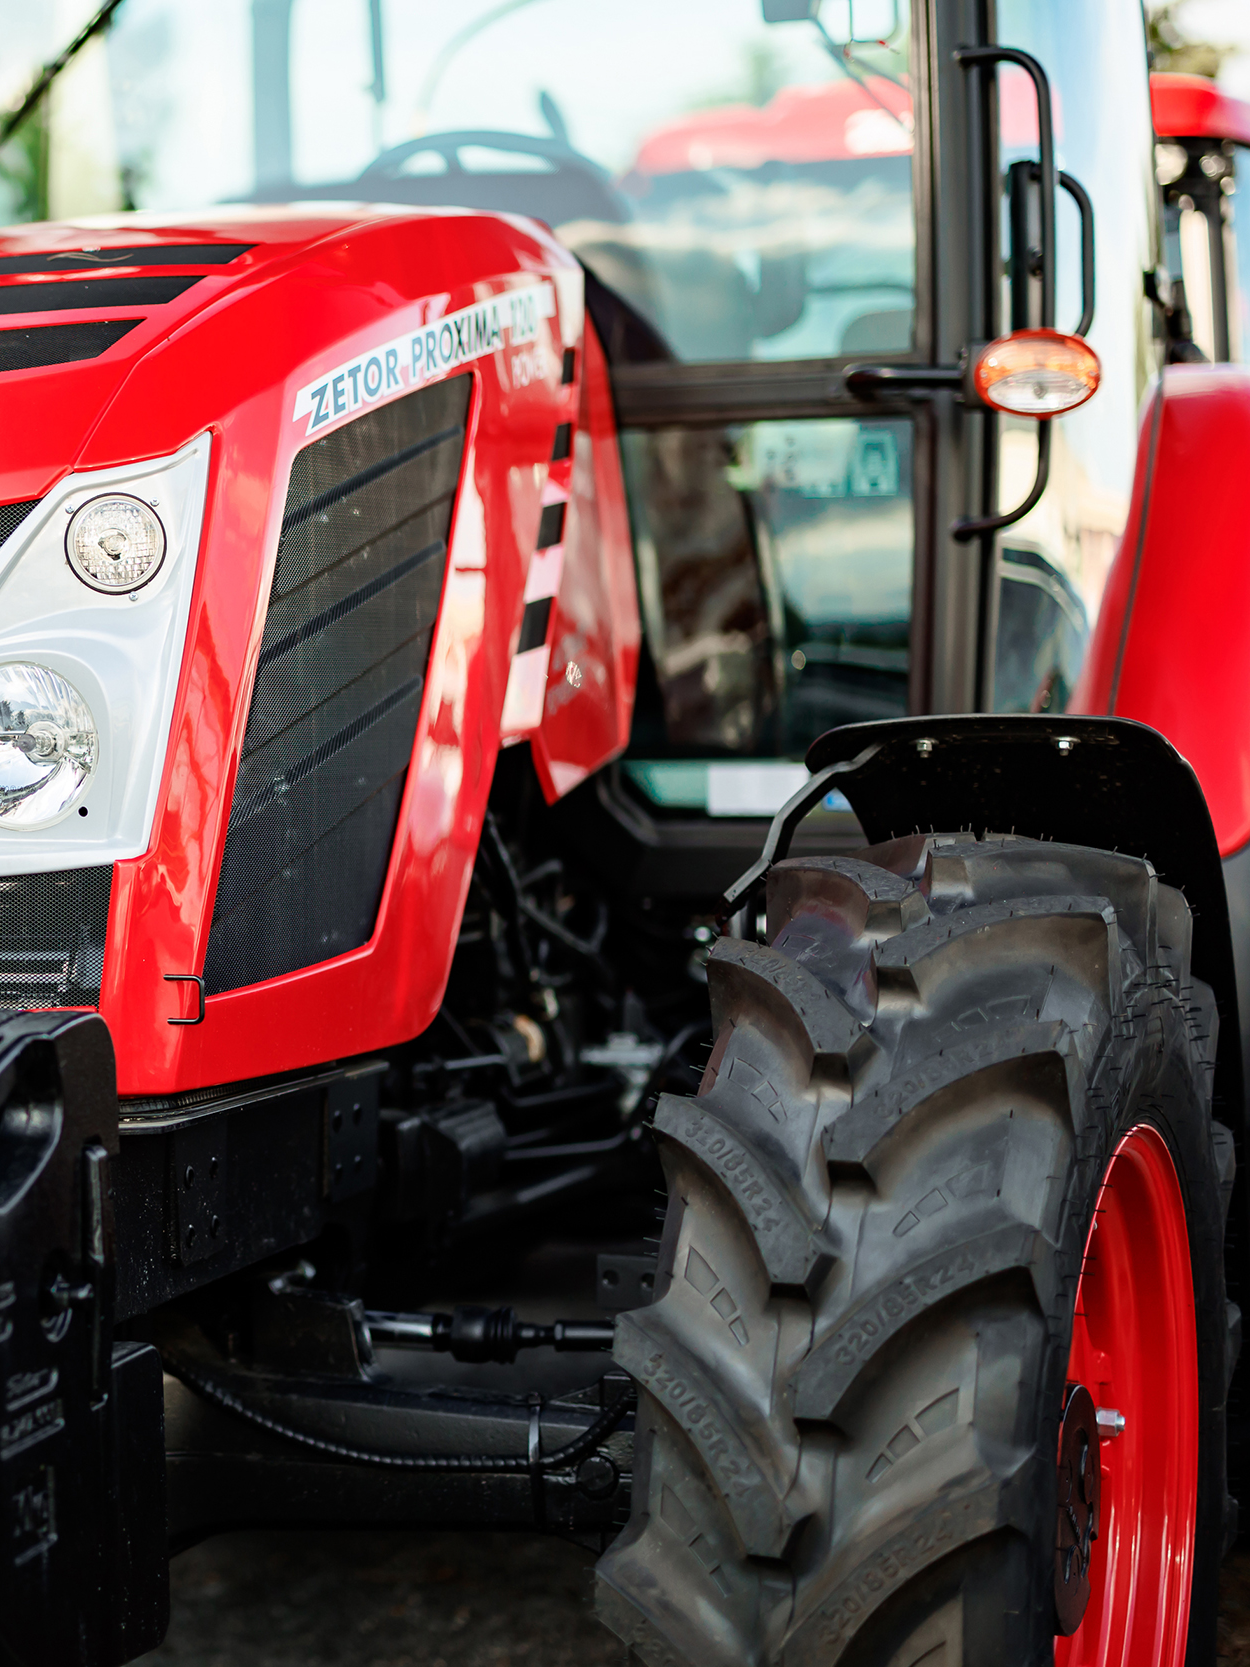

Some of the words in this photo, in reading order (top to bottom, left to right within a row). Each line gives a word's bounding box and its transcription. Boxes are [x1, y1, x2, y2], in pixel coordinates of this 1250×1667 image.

[311, 348, 400, 430] ZETOR
[411, 305, 501, 378] PROXIMA
[510, 347, 551, 390] POWE
[872, 1042, 998, 1119] 320/85R2
[684, 1116, 781, 1233] 320/85R24
[834, 1253, 977, 1366] 320/85R24
[643, 1353, 751, 1498] 320/85R24
[819, 1508, 955, 1646] 320/85R24
